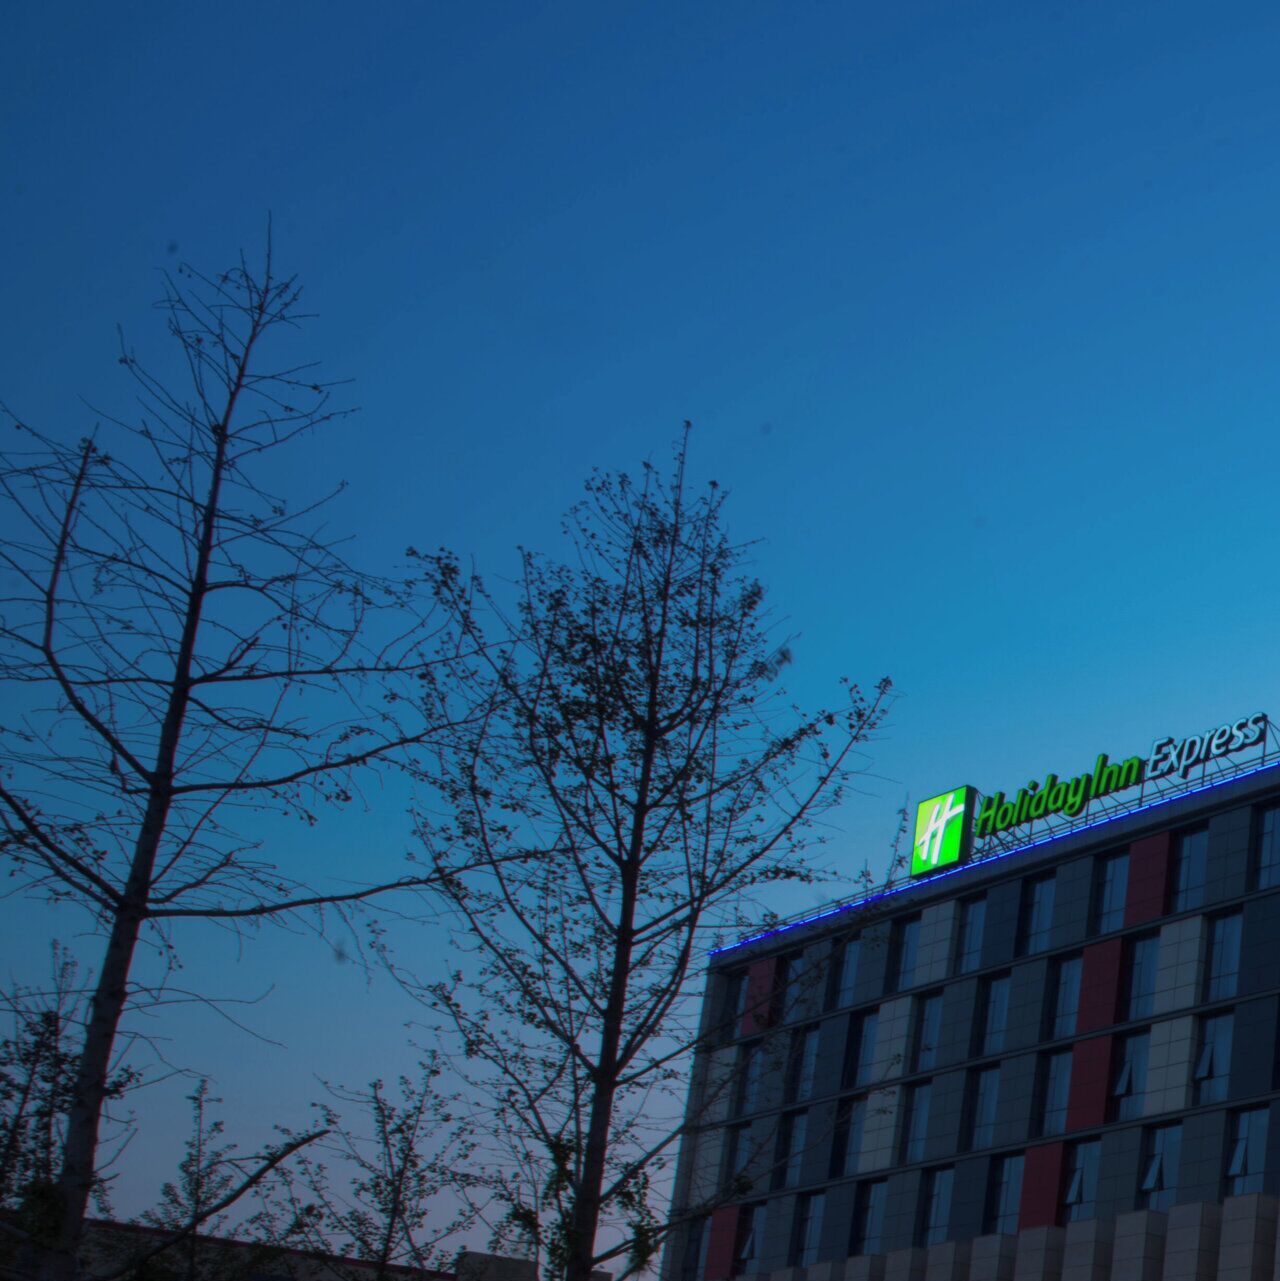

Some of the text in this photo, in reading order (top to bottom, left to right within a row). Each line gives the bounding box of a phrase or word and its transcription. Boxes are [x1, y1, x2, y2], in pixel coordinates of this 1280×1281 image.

[976, 711, 1267, 837] Holiday Inn Express
